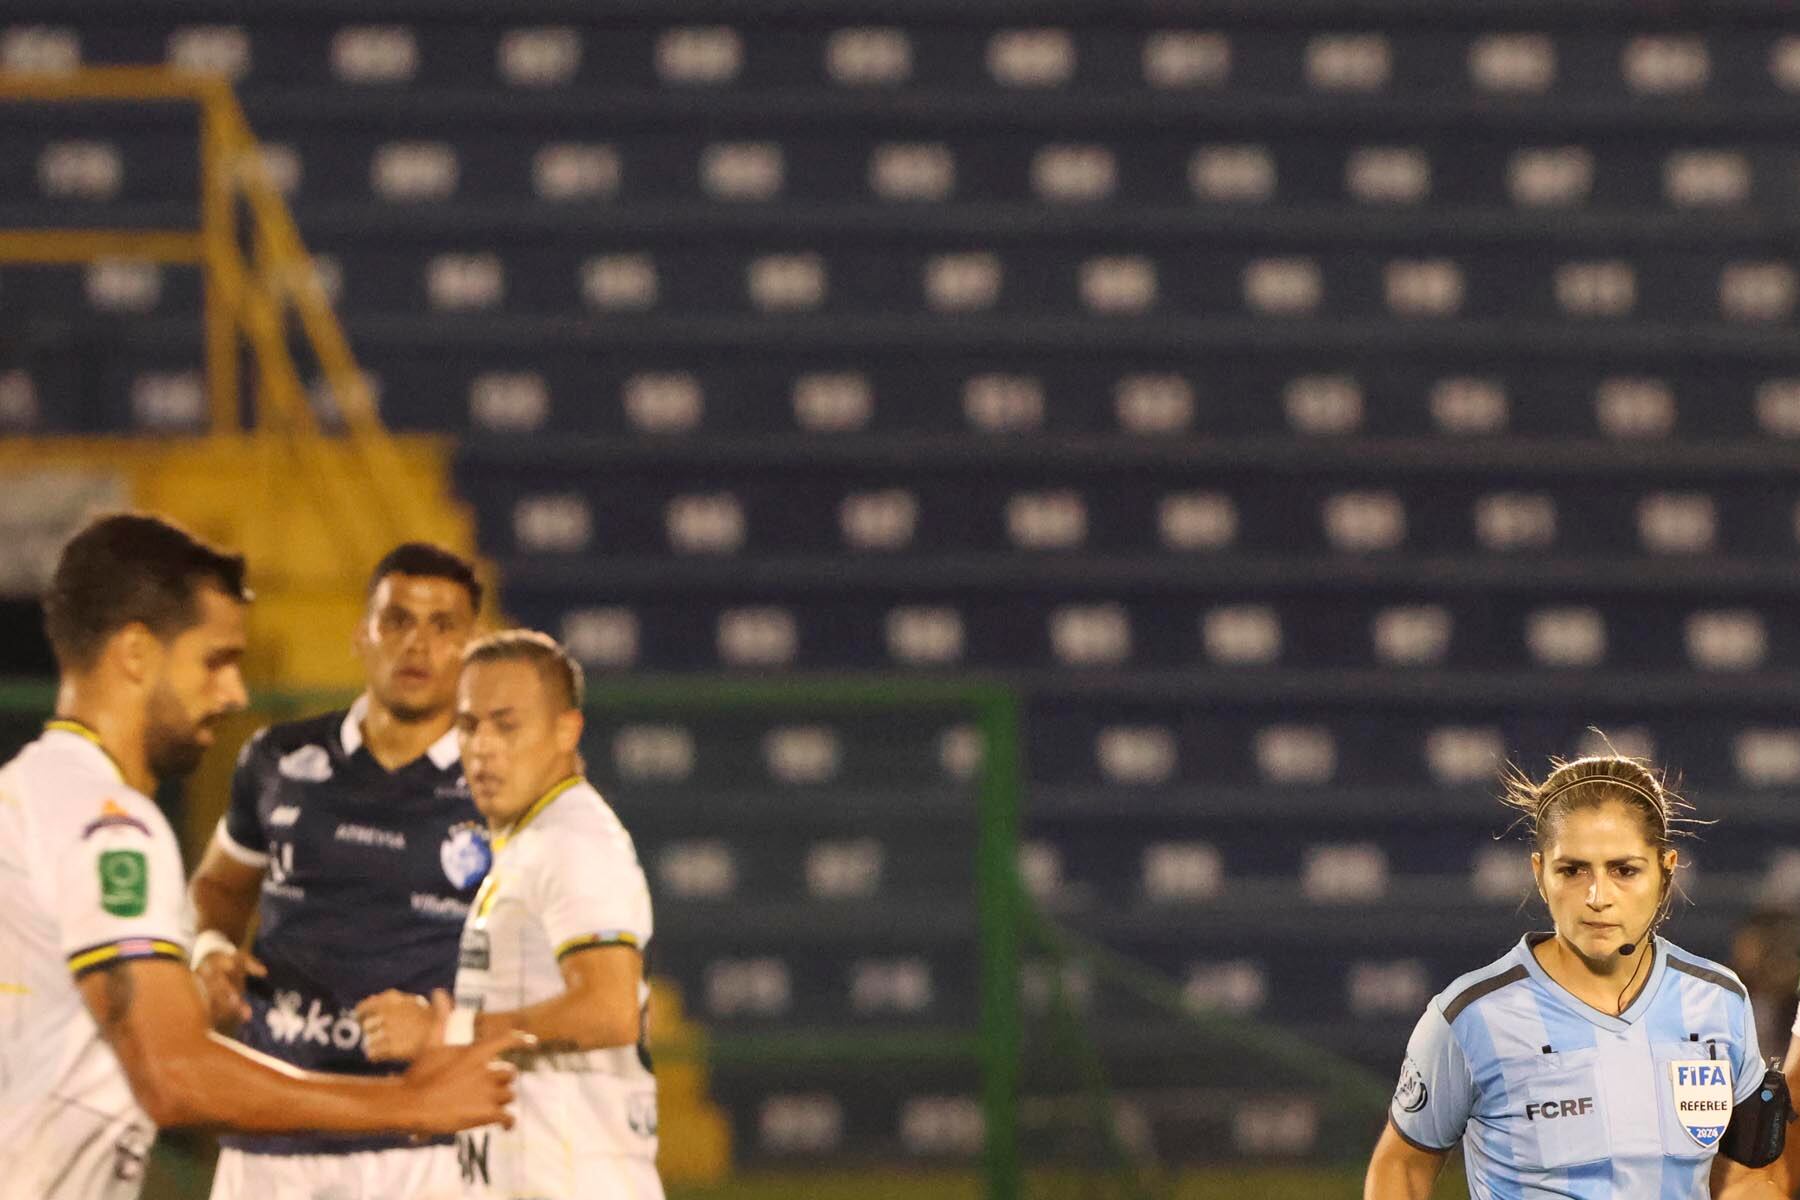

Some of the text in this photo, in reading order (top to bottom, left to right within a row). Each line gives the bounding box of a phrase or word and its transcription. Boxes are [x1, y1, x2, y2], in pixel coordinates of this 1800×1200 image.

[1678, 1065, 1727, 1087] FIFA
[1526, 1096, 1594, 1121] FCRF
[1679, 1100, 1729, 1112] REFEREE
